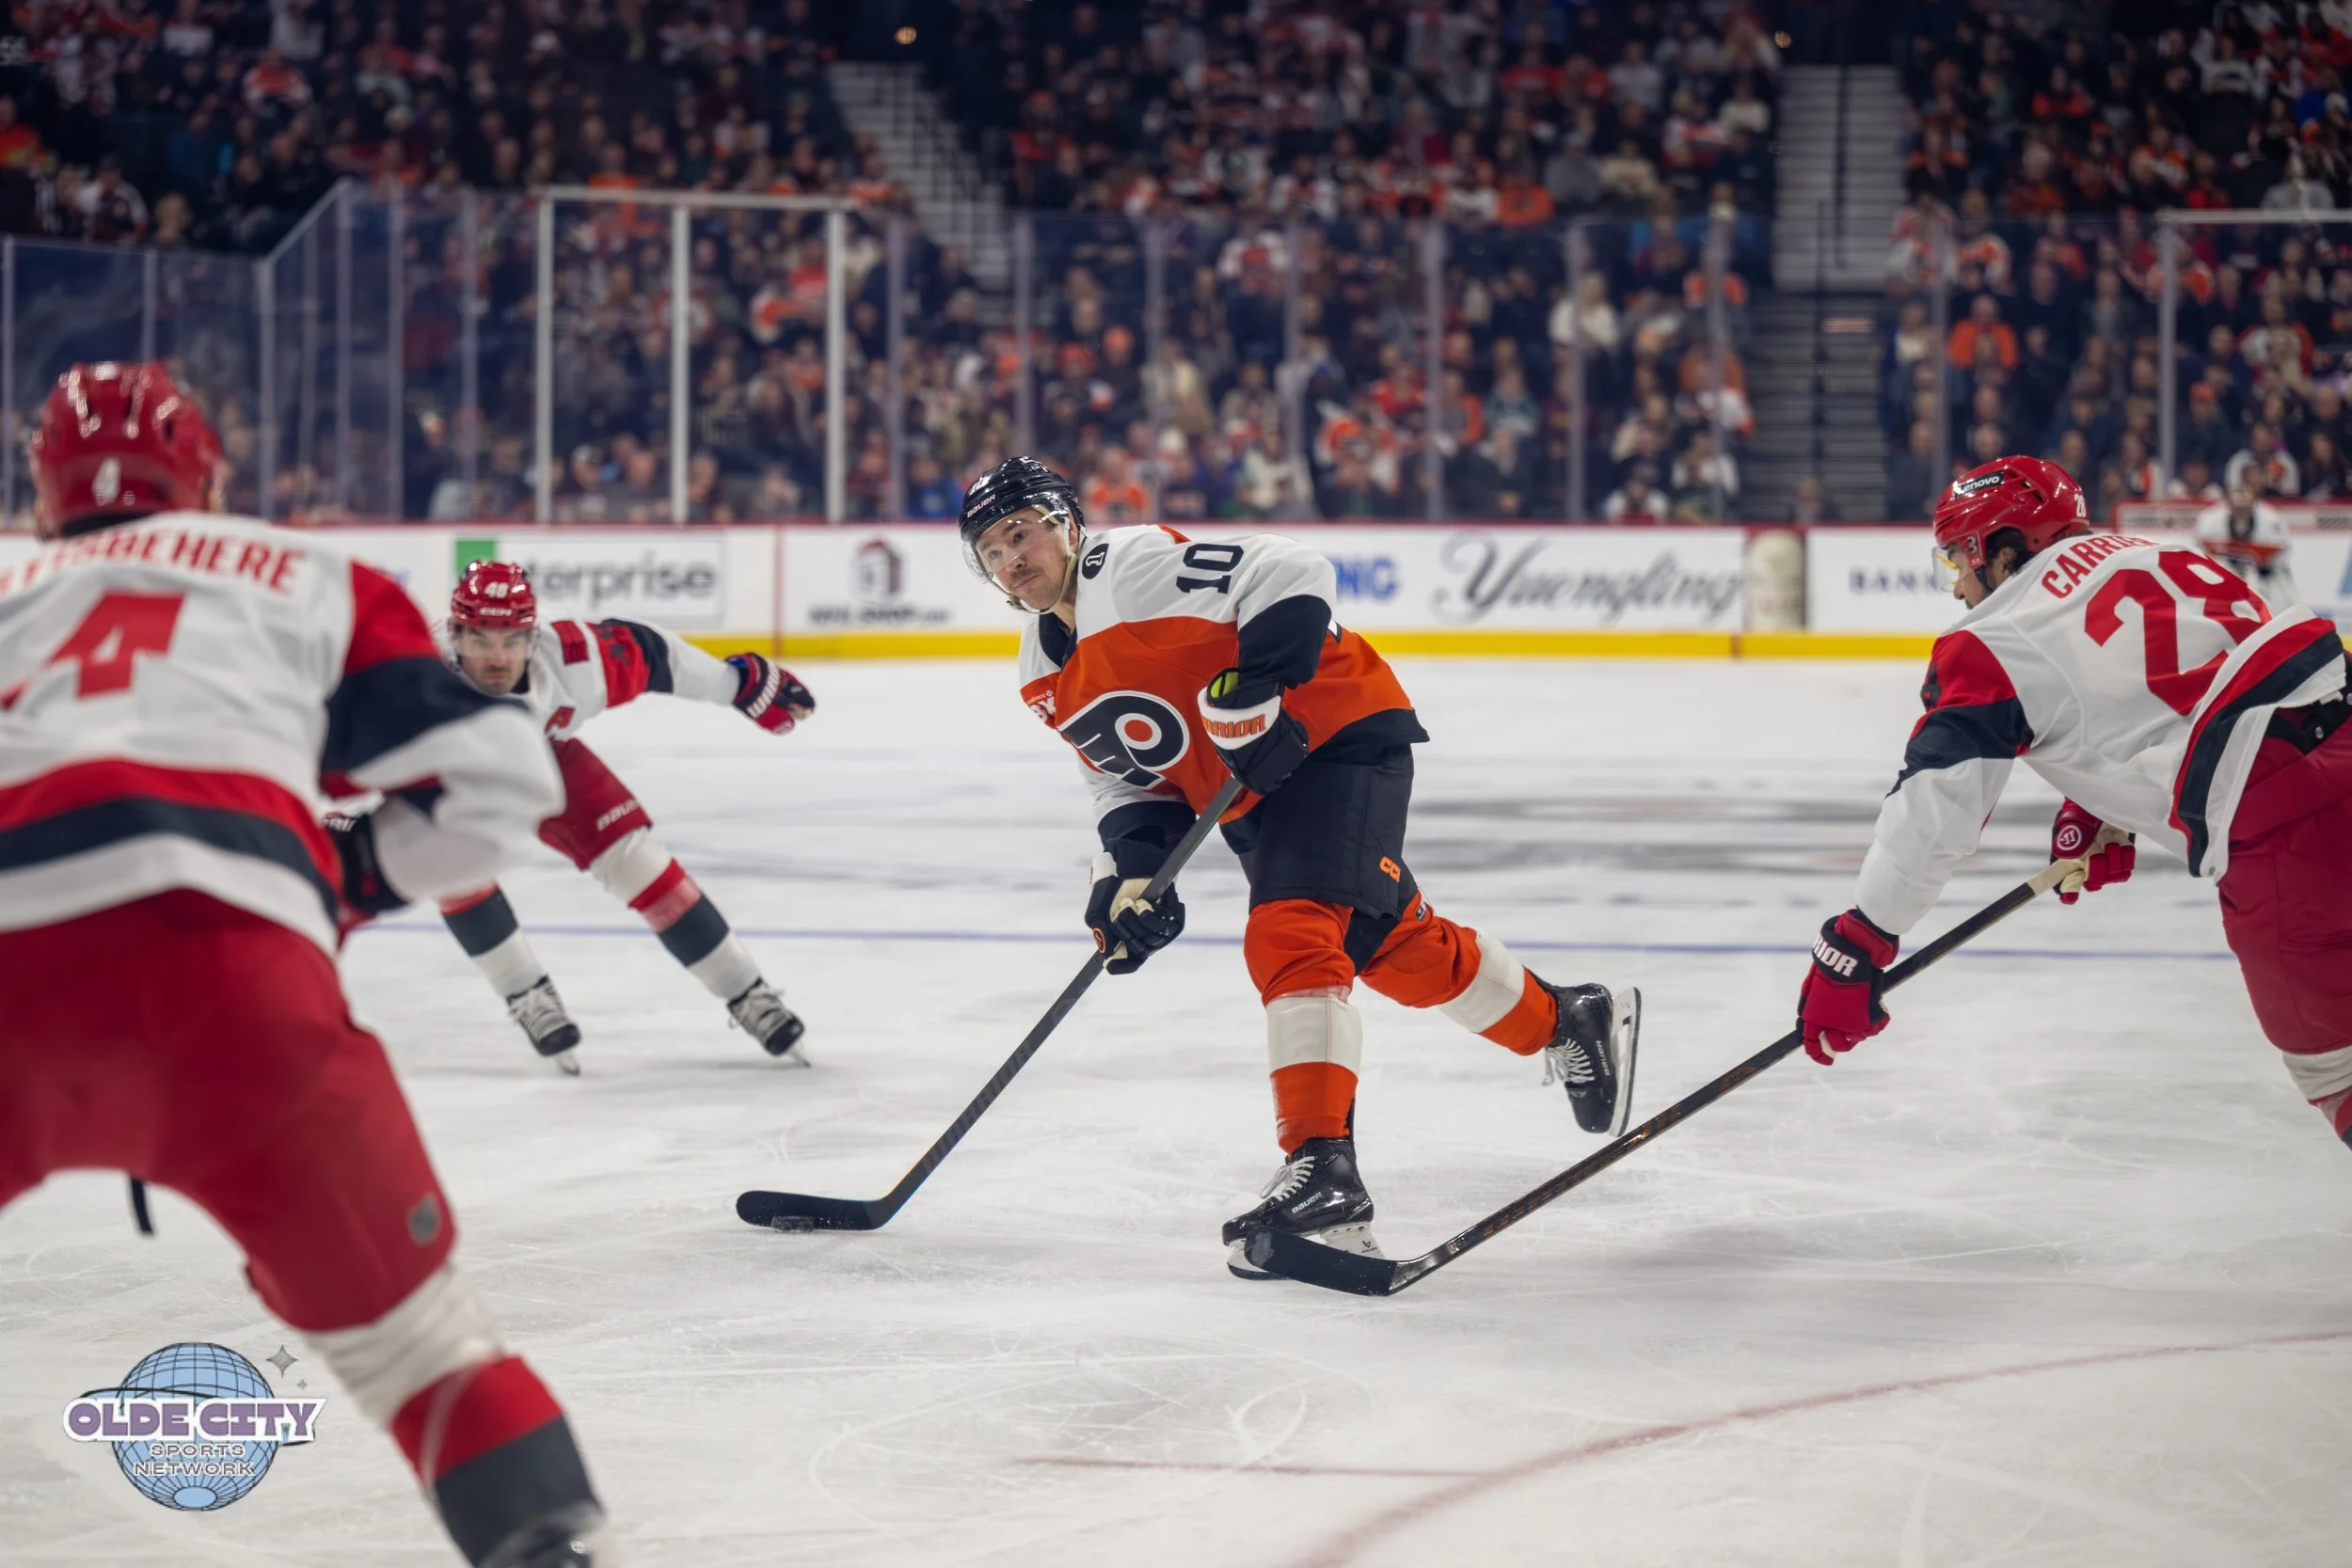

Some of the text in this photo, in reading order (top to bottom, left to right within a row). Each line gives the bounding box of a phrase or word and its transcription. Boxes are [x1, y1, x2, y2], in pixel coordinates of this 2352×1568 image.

[967, 494, 996, 517] BAUER
[1176, 543, 1245, 594] 10
[1428, 530, 1744, 626] Yuengling
[484, 581, 509, 599] 48
[47, 587, 185, 698] 4
[2084, 550, 2272, 717] 28
[1201, 714, 1267, 738] RRIOR
[1379, 857, 1401, 882] CC
[1292, 1191, 1323, 1214] BAUER
